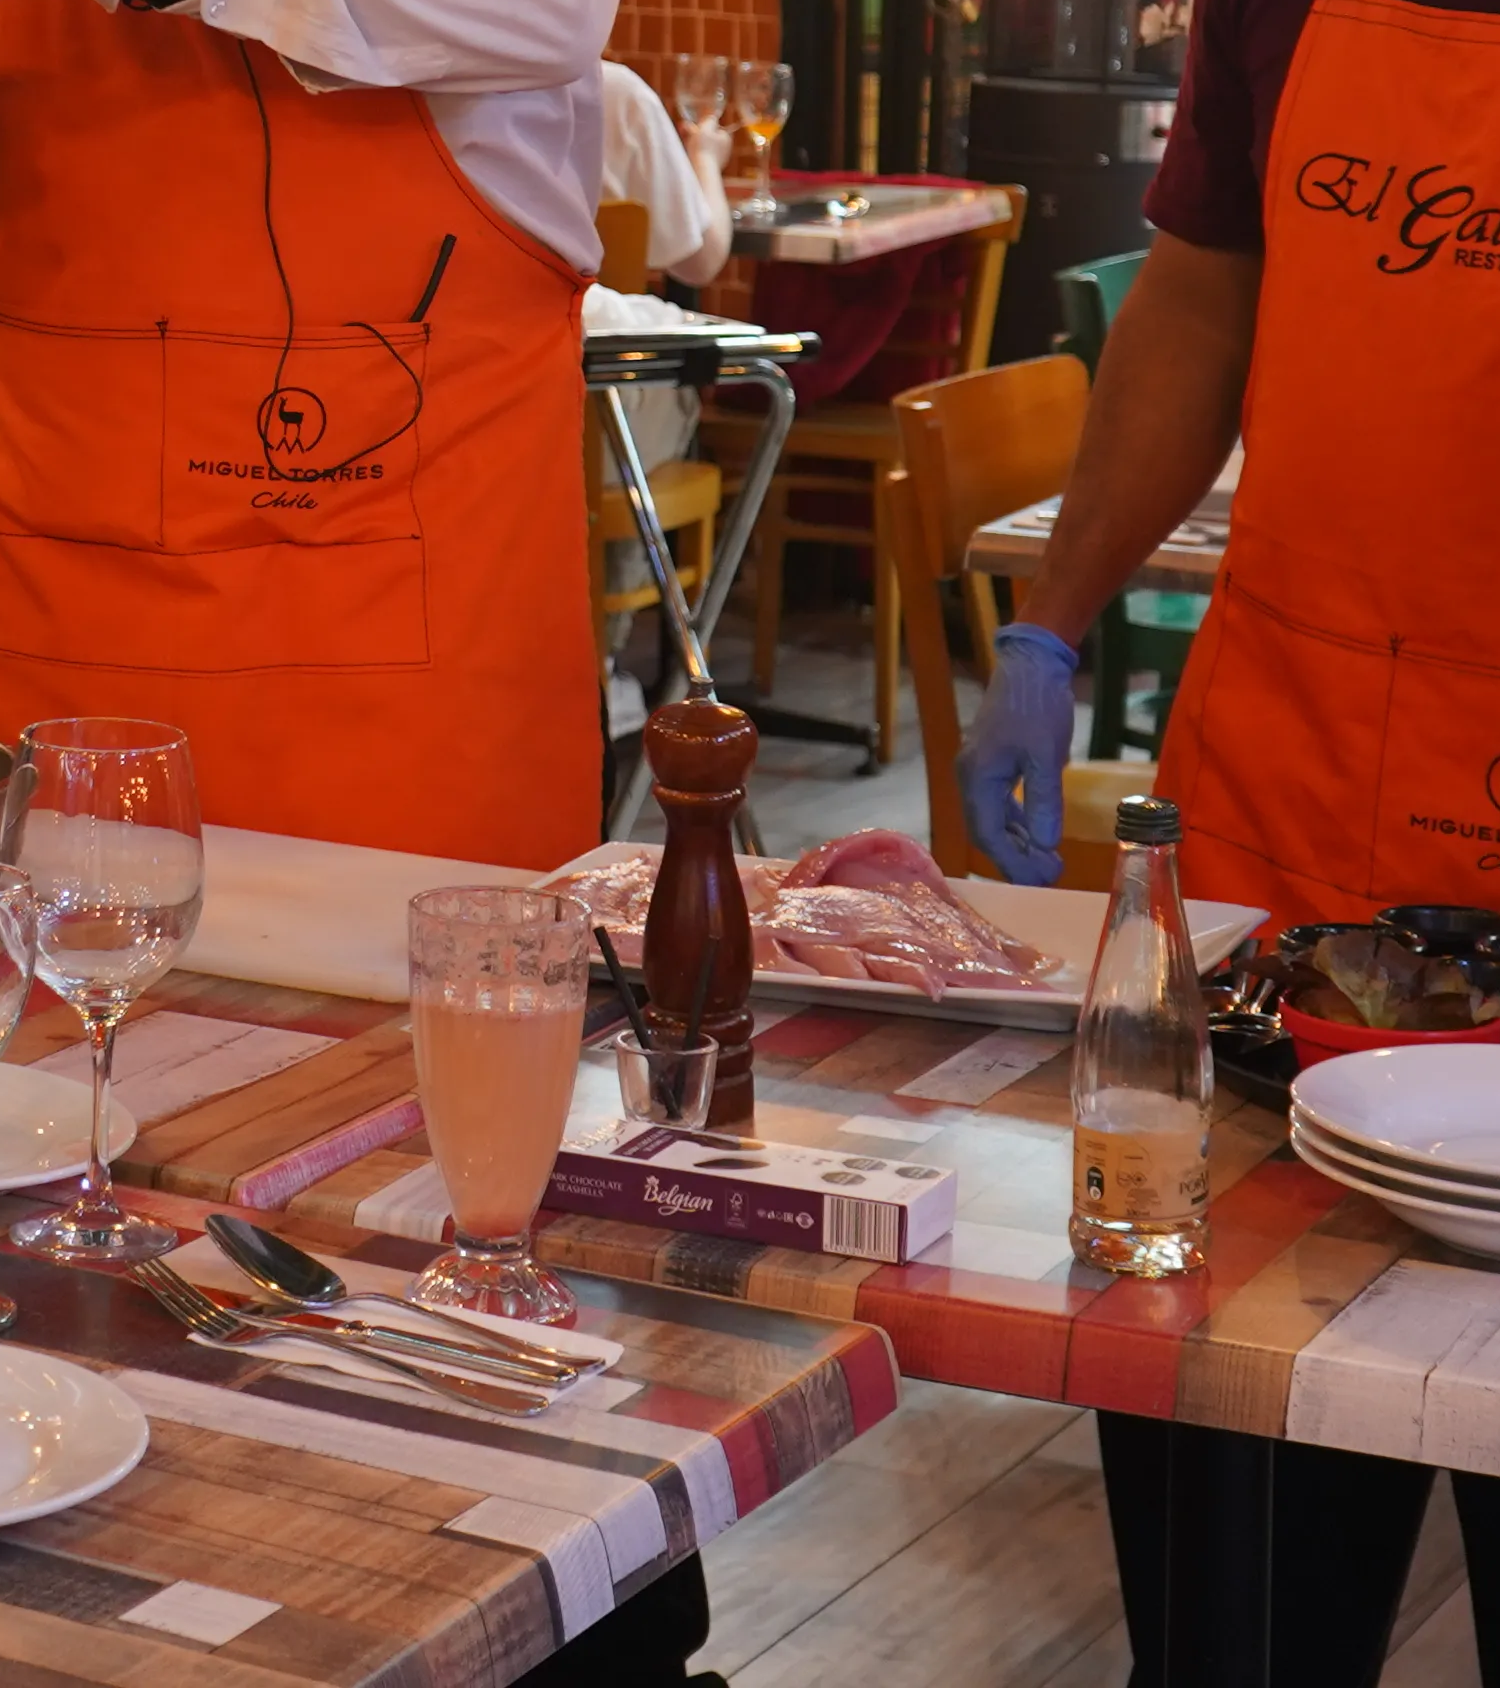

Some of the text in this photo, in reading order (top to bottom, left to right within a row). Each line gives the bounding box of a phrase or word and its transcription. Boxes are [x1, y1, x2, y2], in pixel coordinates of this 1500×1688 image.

[1296, 152, 1397, 222] El
[188, 459, 384, 483] MIGUEL TORRES
[251, 491, 319, 510] Chile
[551, 1173, 624, 1191] ARK CHOCOLATE
[643, 1184, 715, 1216] Belgian
